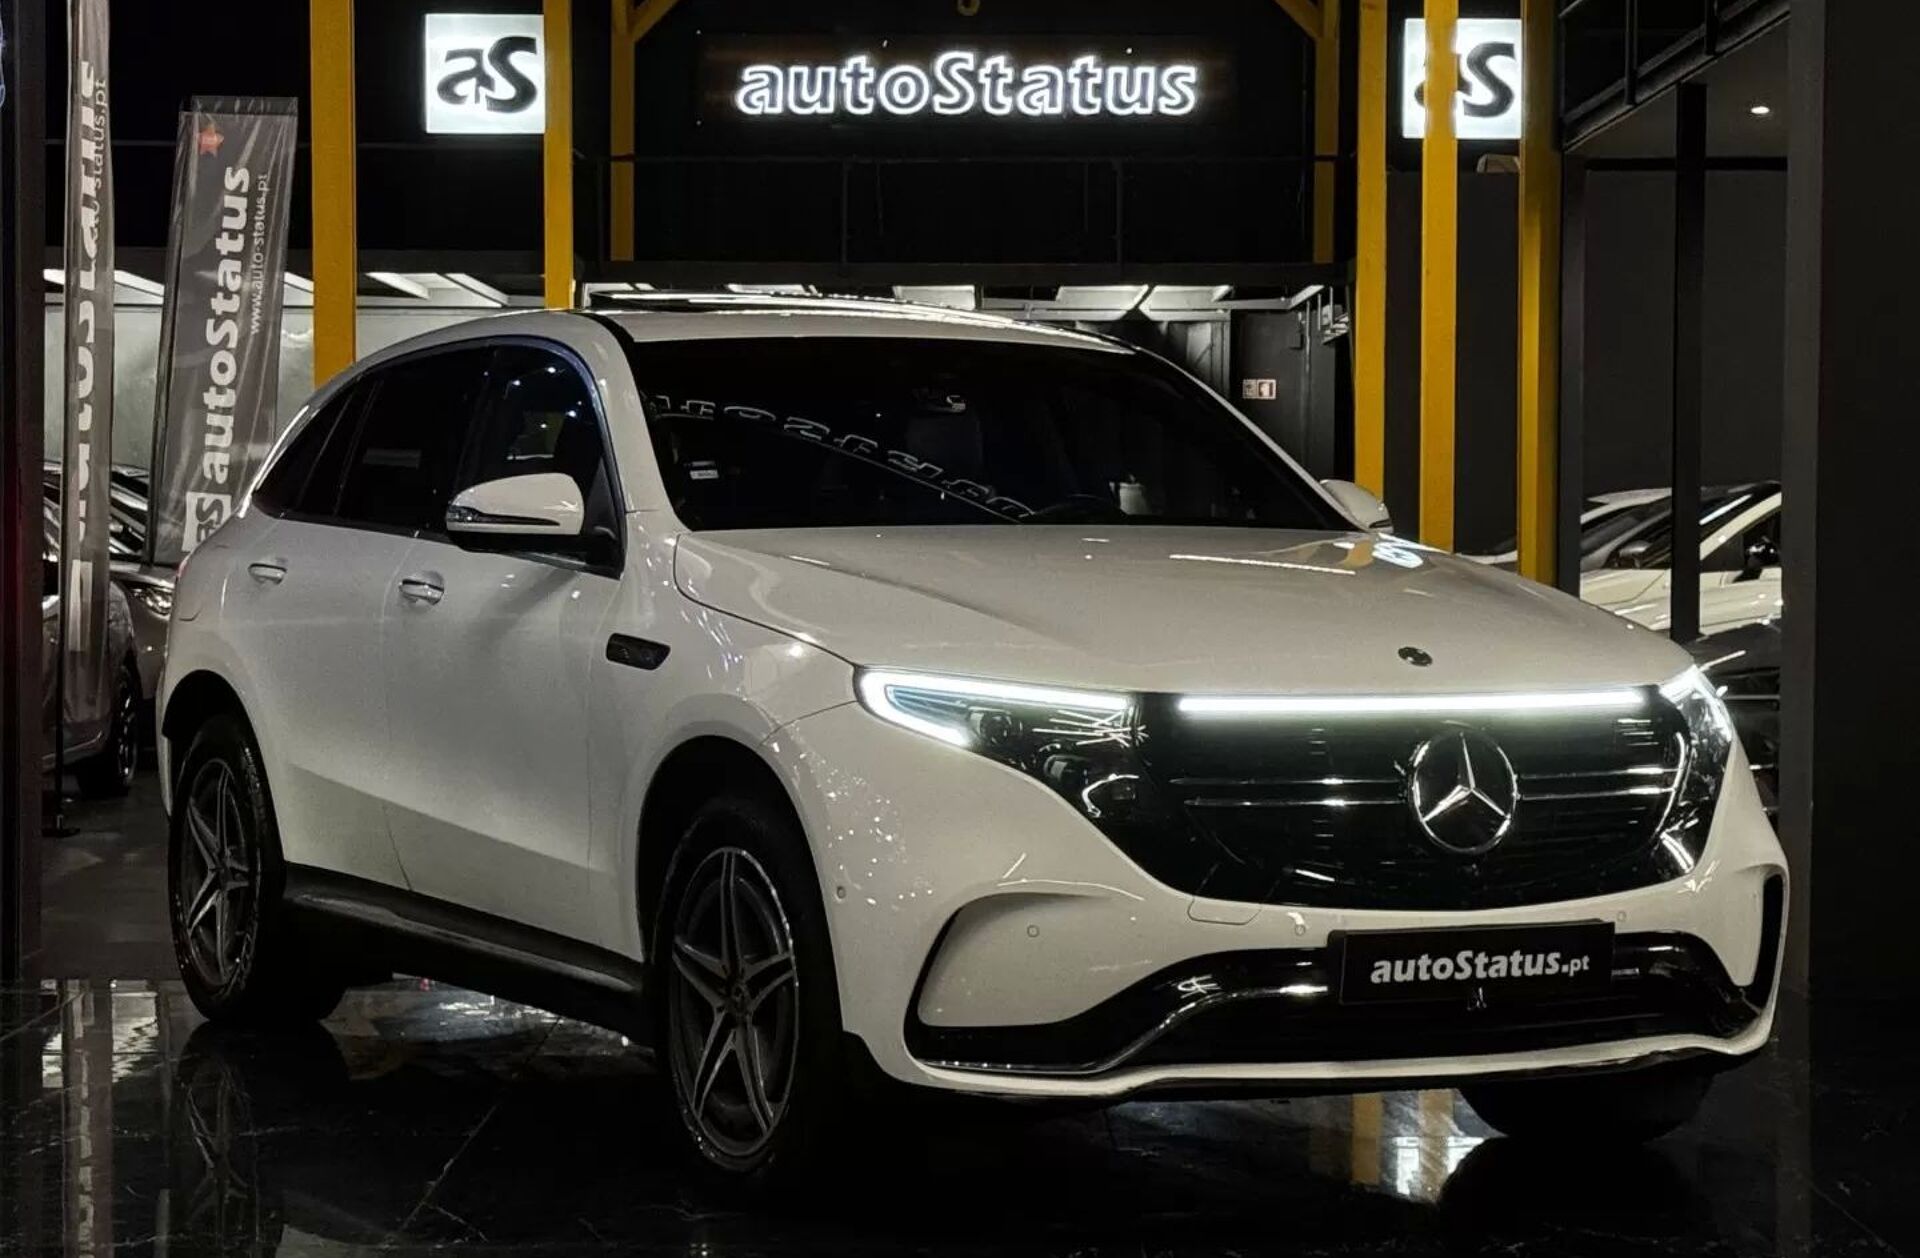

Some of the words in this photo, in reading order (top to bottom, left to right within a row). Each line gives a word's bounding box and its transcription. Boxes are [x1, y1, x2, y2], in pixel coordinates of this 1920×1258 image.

[734, 50, 1199, 116] autoStatus
[249, 173, 270, 336] www.auto-status.pt
[203, 166, 250, 484] autoStatus
[1370, 950, 1590, 984] autoStatus.pt
